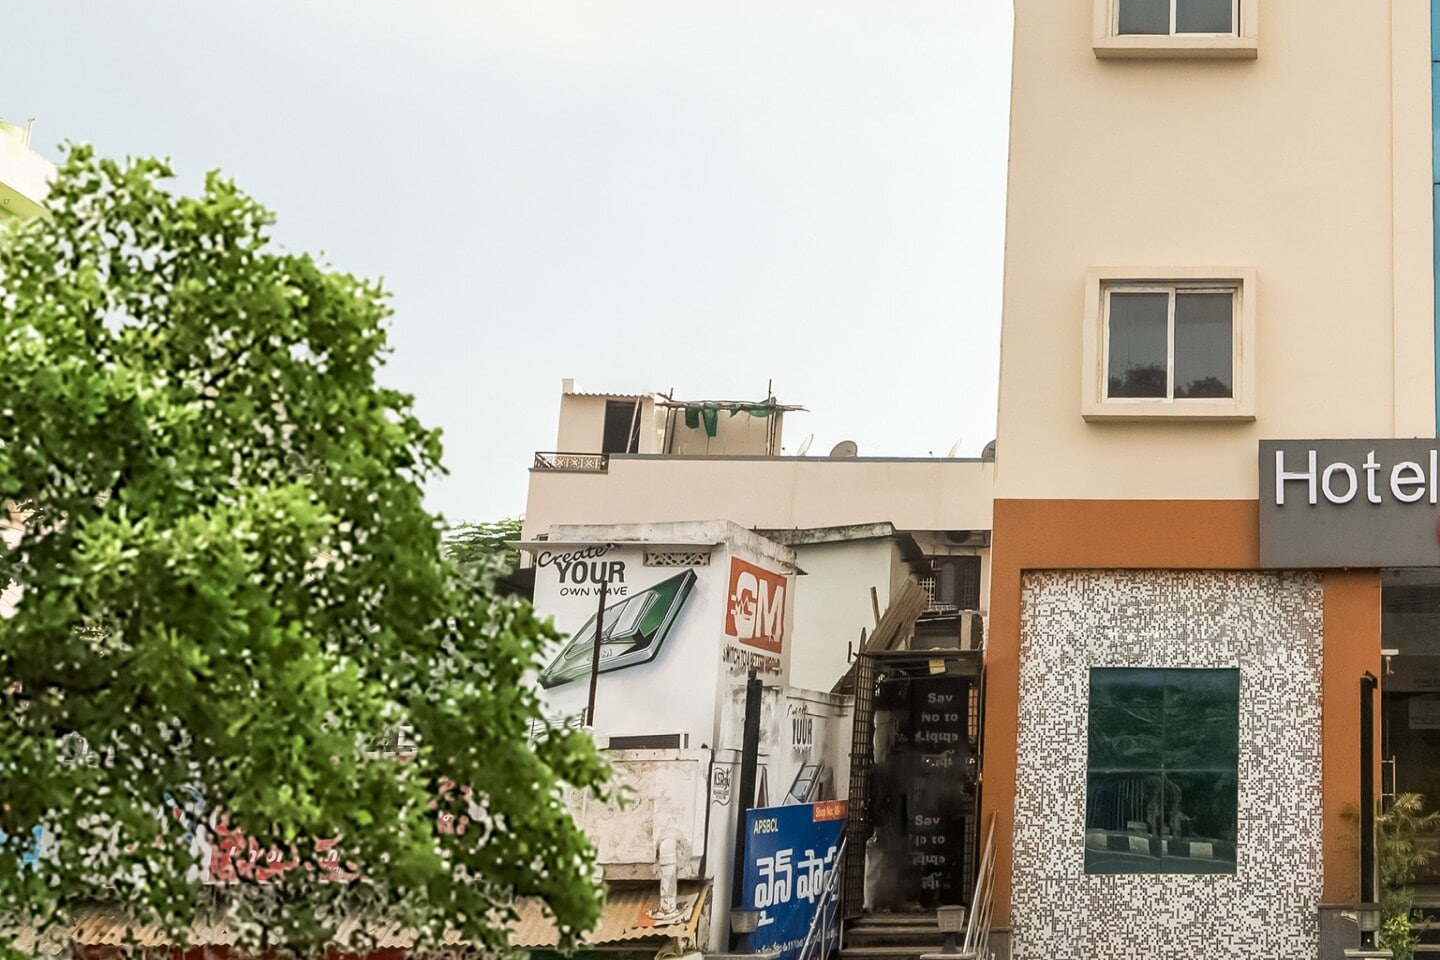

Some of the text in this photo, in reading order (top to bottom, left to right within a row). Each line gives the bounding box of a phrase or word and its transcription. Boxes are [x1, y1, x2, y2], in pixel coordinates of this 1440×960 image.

[1275, 449, 1438, 505] Hotel
[538, 542, 611, 568] Create
[556, 560, 626, 585] YOUR
[559, 585, 629, 597] OWN WAVE
[753, 818, 779, 835] APSBCL
